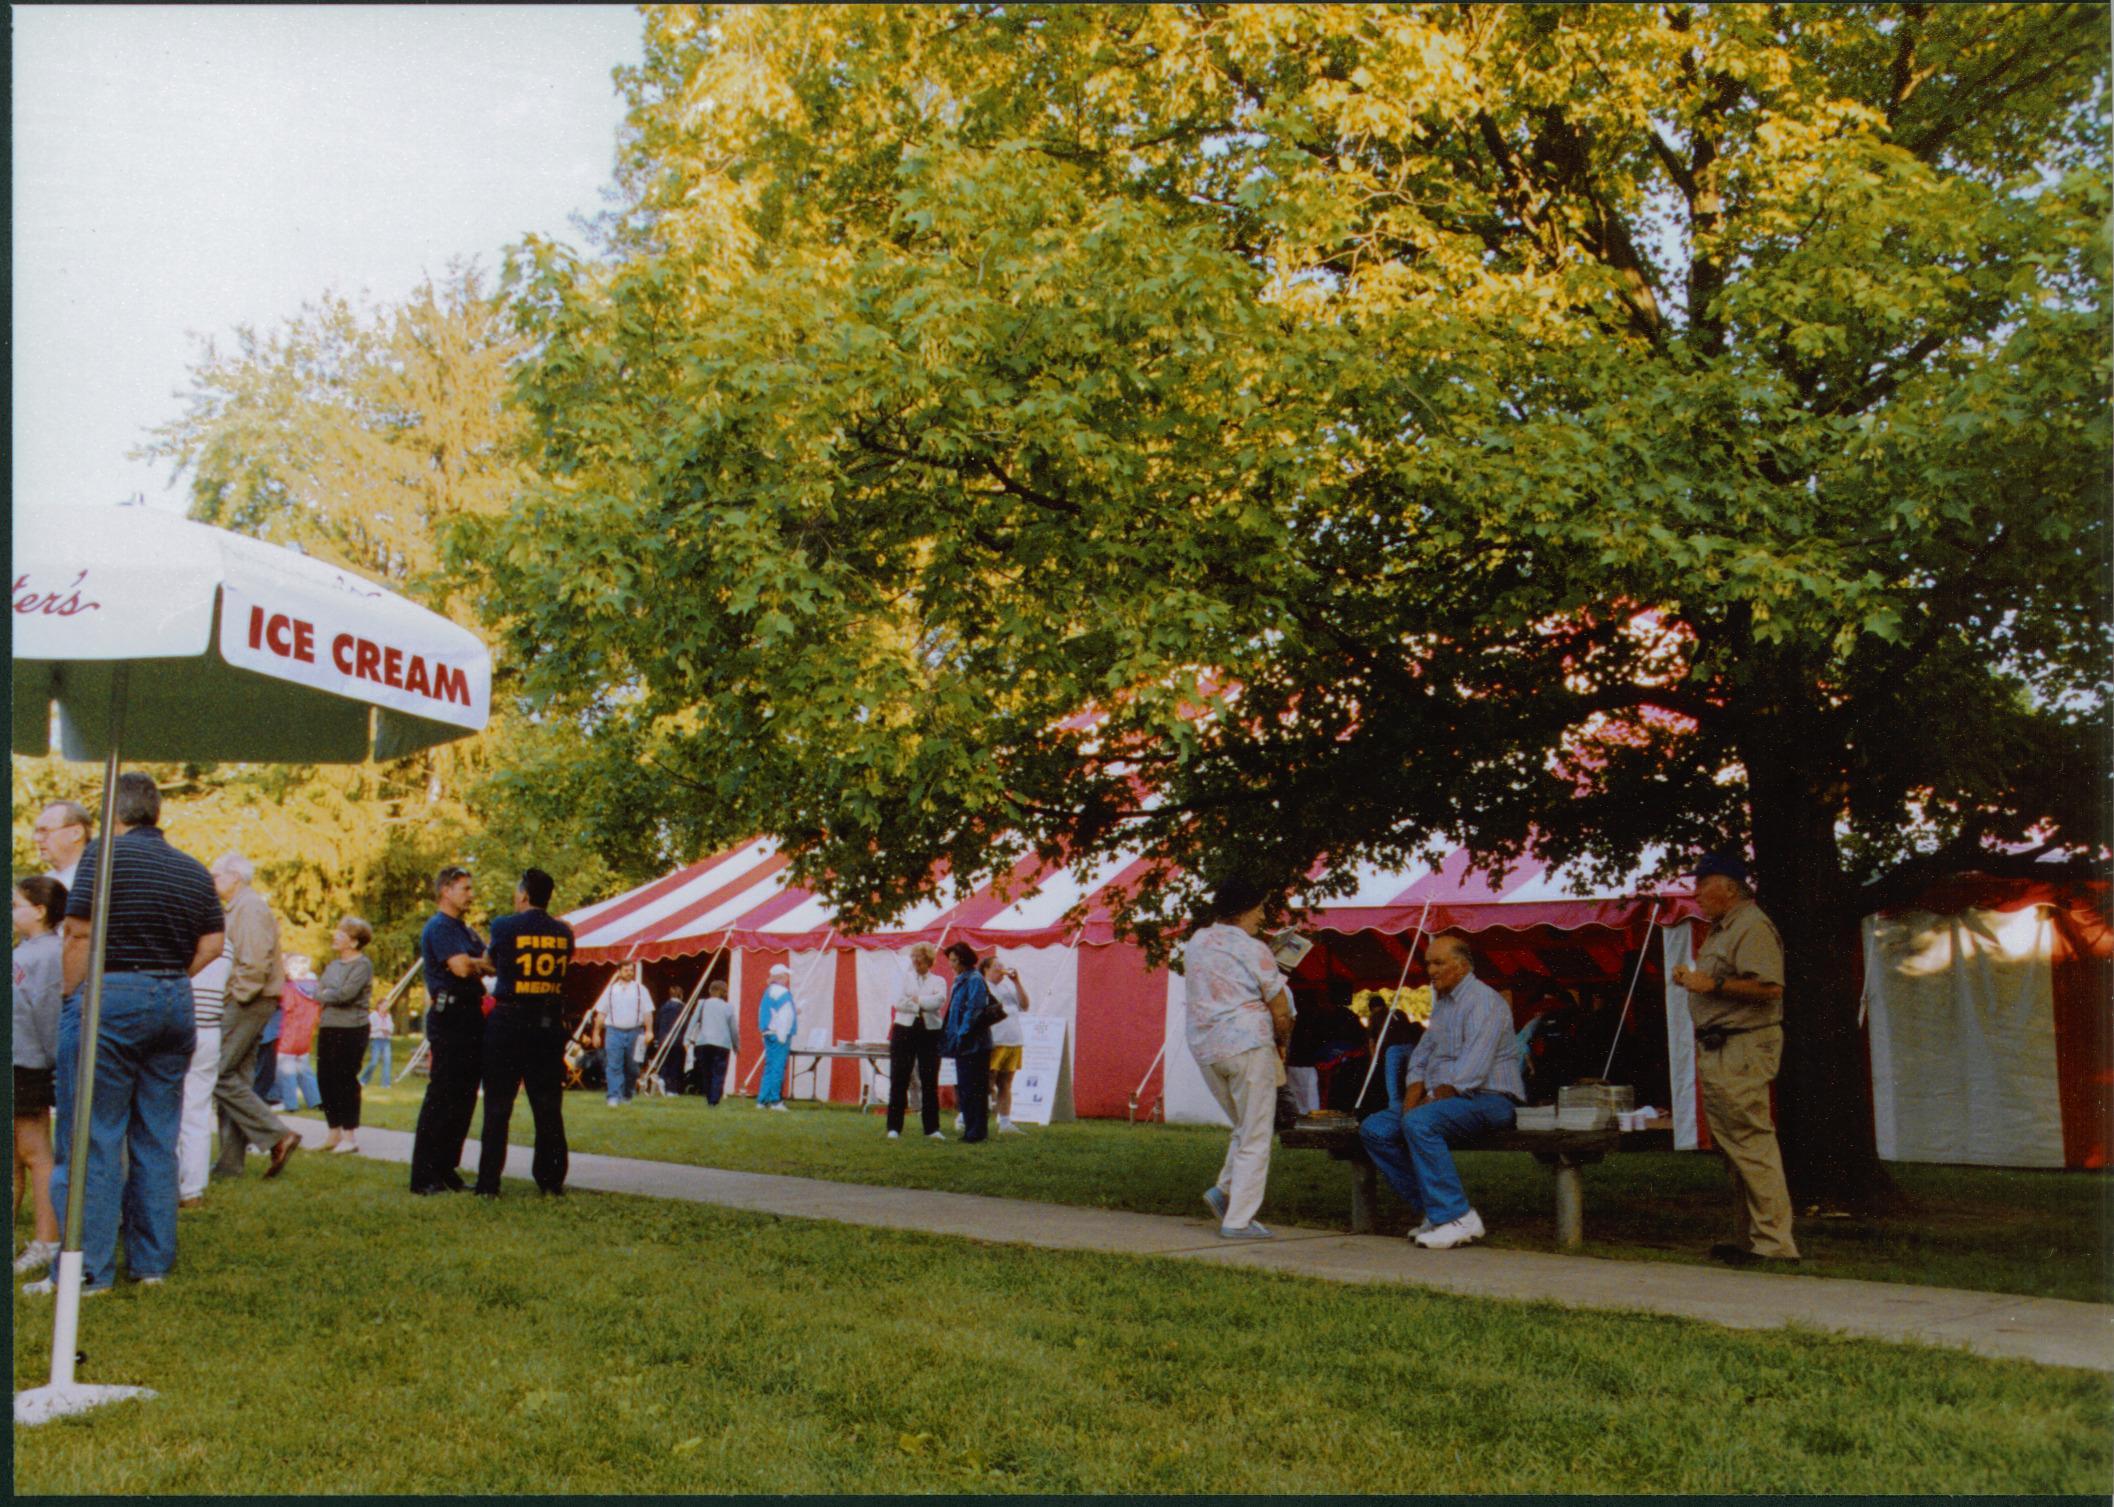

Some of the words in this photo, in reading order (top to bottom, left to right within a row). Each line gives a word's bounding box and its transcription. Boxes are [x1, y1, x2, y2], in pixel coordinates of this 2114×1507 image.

[248, 605, 315, 664] ICE
[332, 633, 471, 707] CREAM
[516, 935, 568, 949] FIRE
[515, 953, 568, 977] 101
